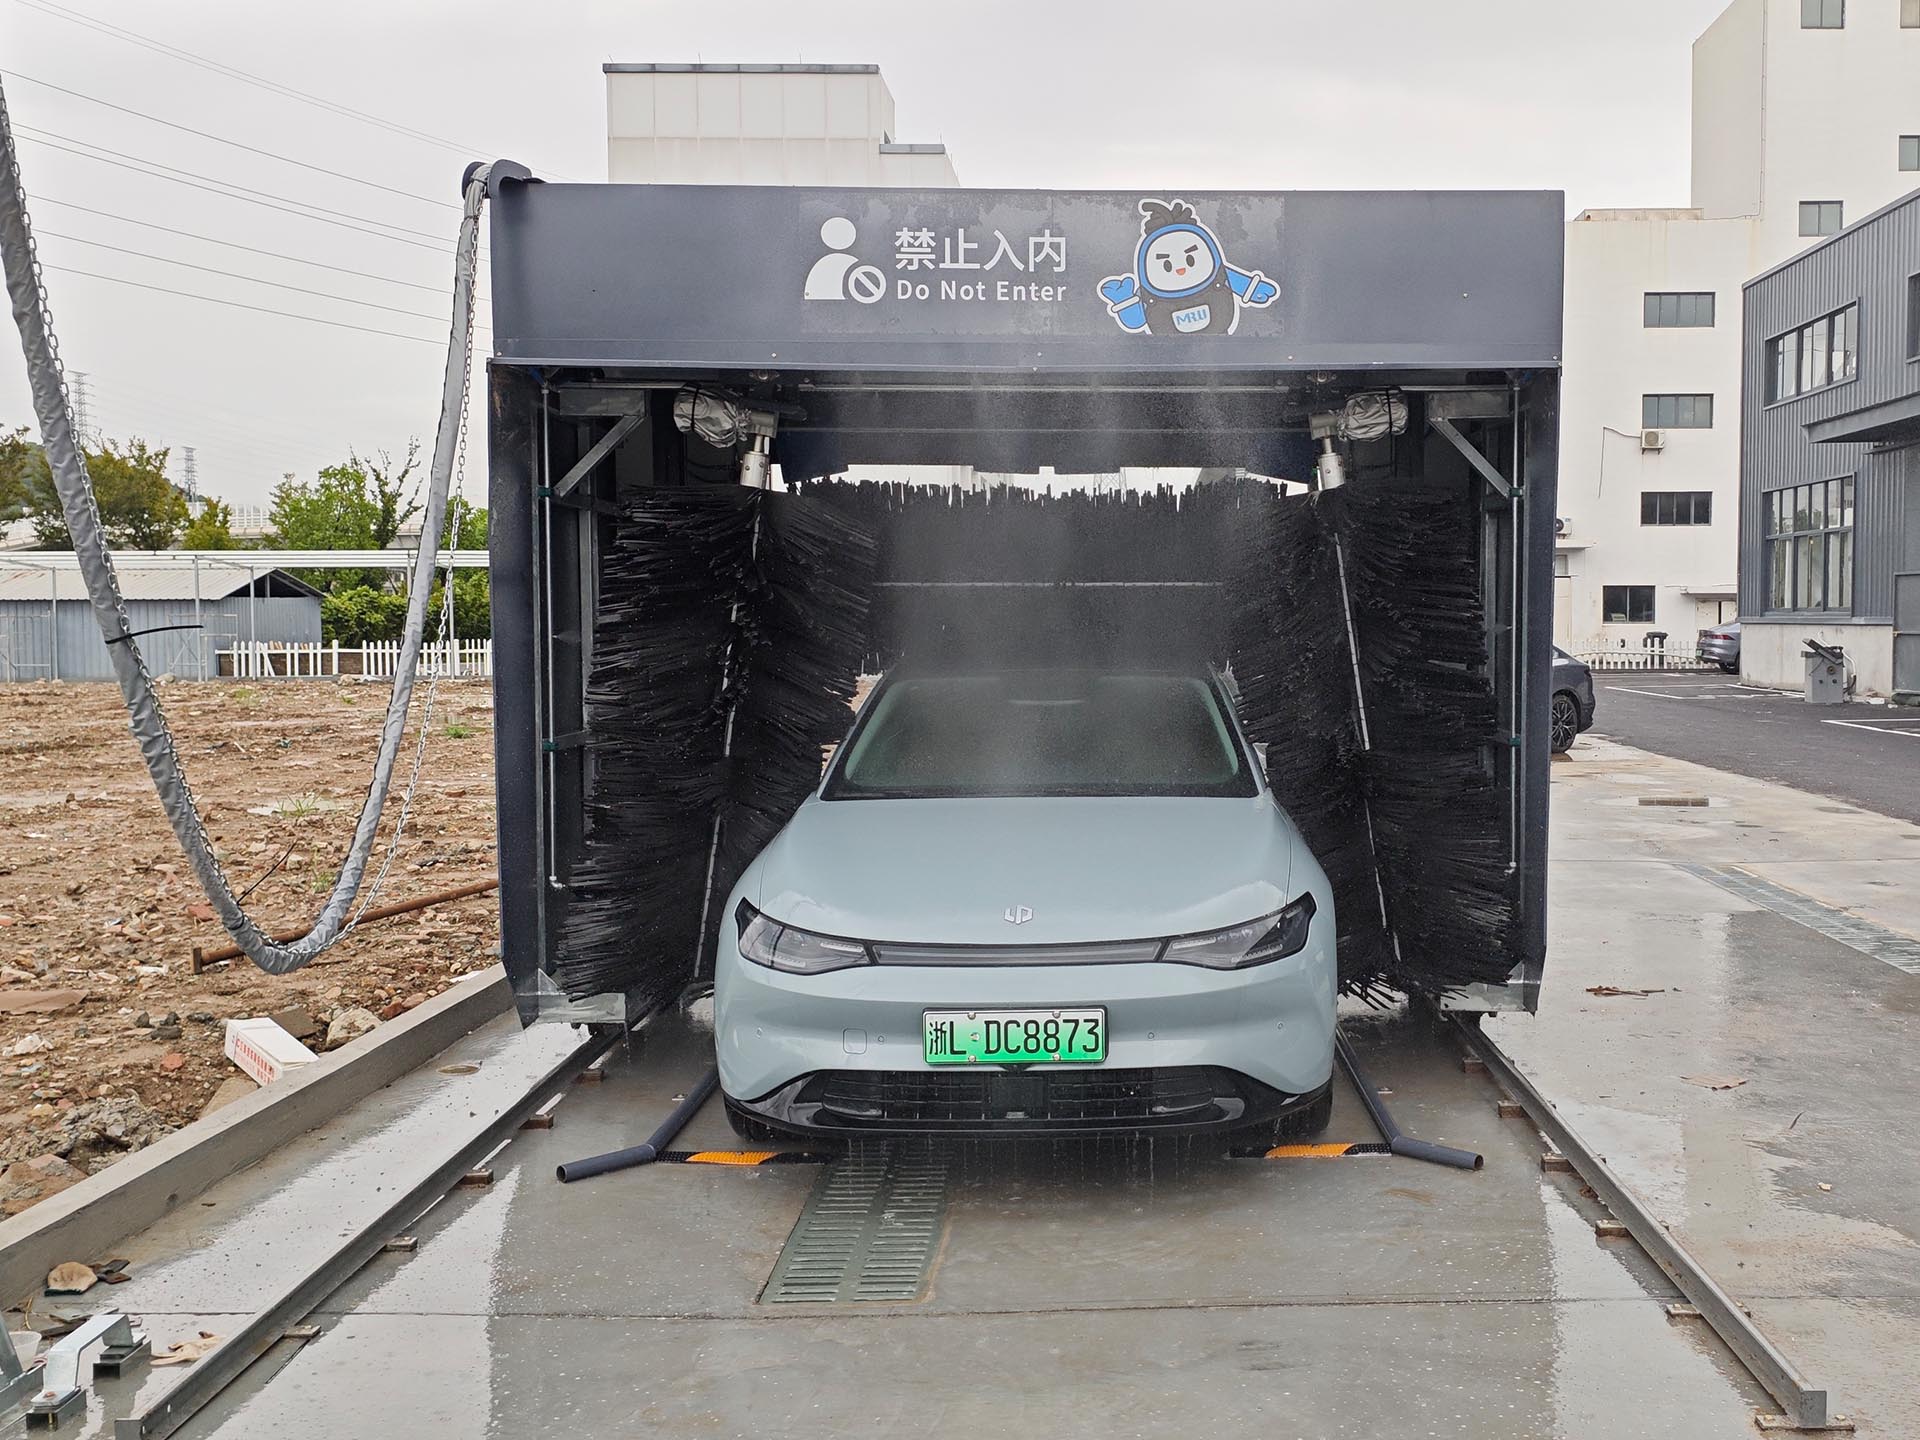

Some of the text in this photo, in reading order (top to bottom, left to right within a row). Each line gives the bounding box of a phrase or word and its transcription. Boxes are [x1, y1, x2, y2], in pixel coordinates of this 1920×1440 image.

[894, 227, 1067, 273] 禁止入内
[897, 279, 1067, 302] Do Not Enter
[984, 1018, 1100, 1055] DC8873
